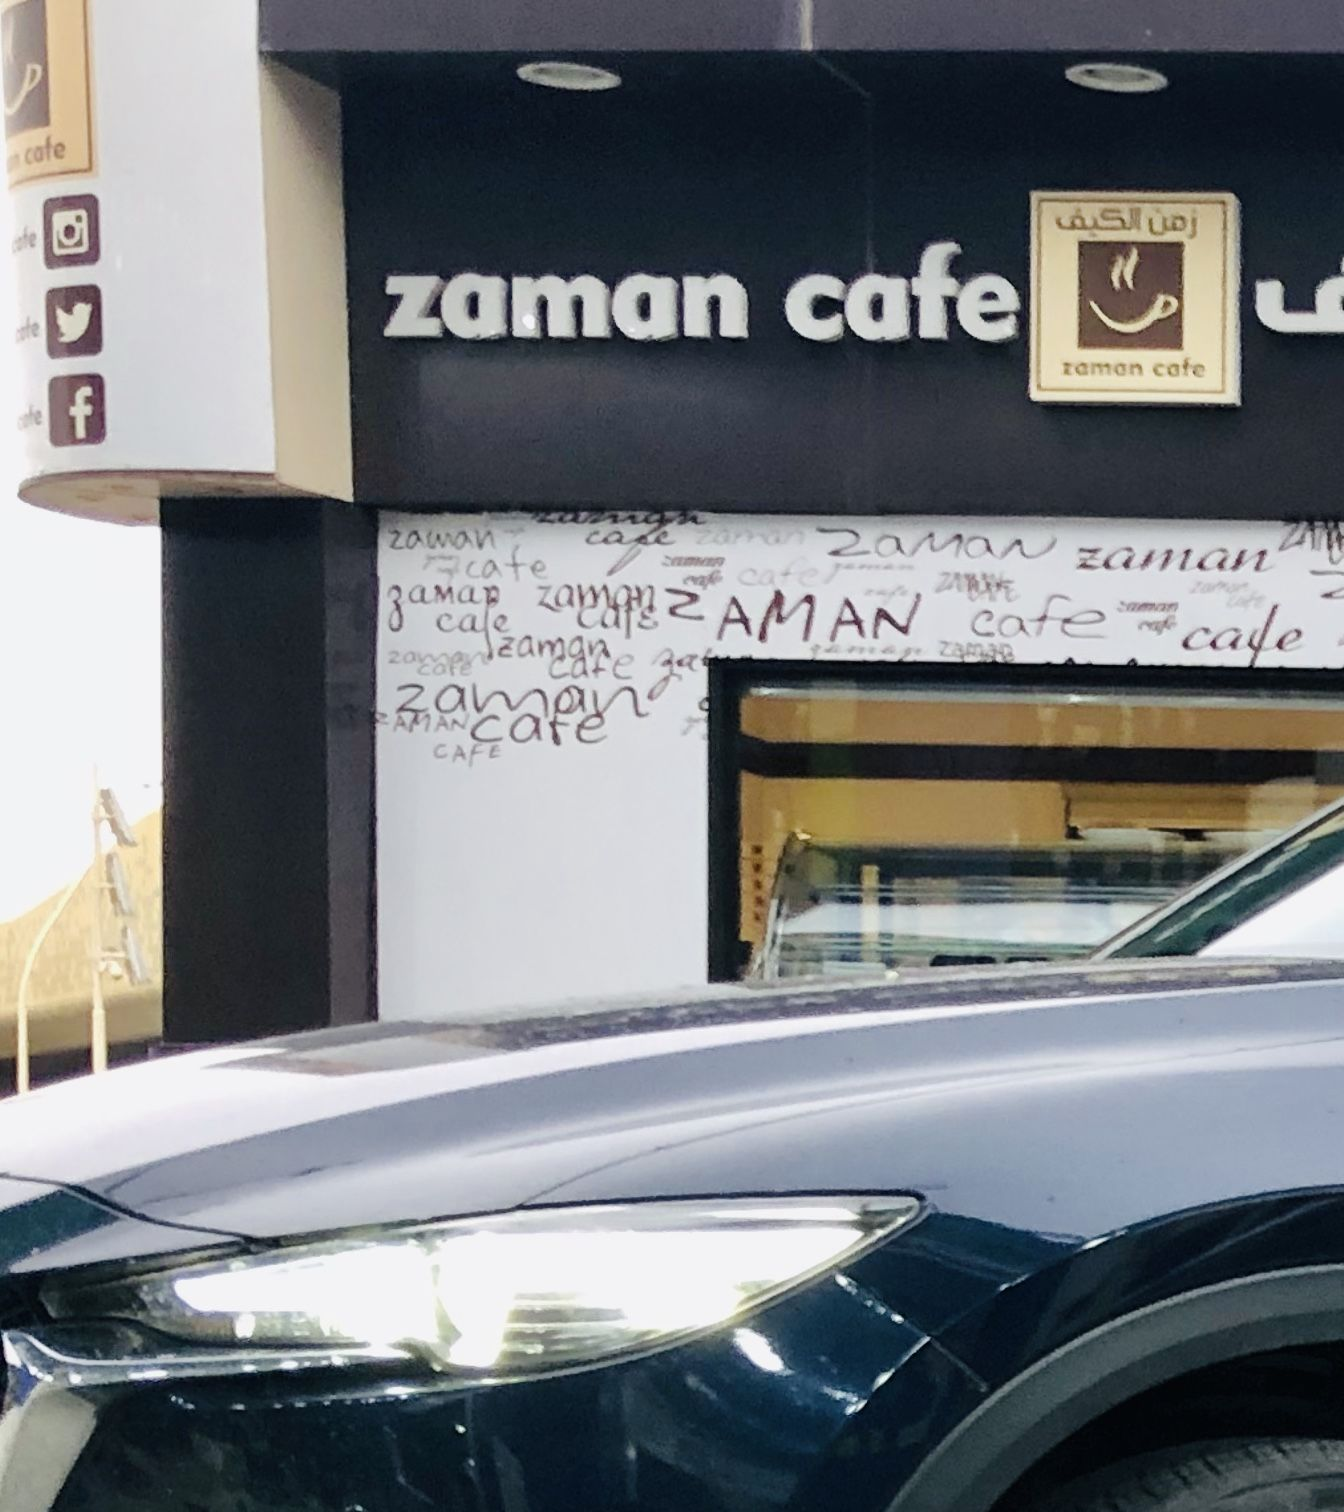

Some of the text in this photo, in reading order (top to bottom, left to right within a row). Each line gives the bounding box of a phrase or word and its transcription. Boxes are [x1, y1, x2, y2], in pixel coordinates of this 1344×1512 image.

[1055, 206, 1199, 240] زمن الكيف
[384, 240, 1020, 342] zaman cafe
[1061, 356, 1206, 378] zaman cafe
[1075, 545, 1276, 573] zaman
[663, 588, 923, 643] ZAMAN
[970, 593, 1108, 639] cafe
